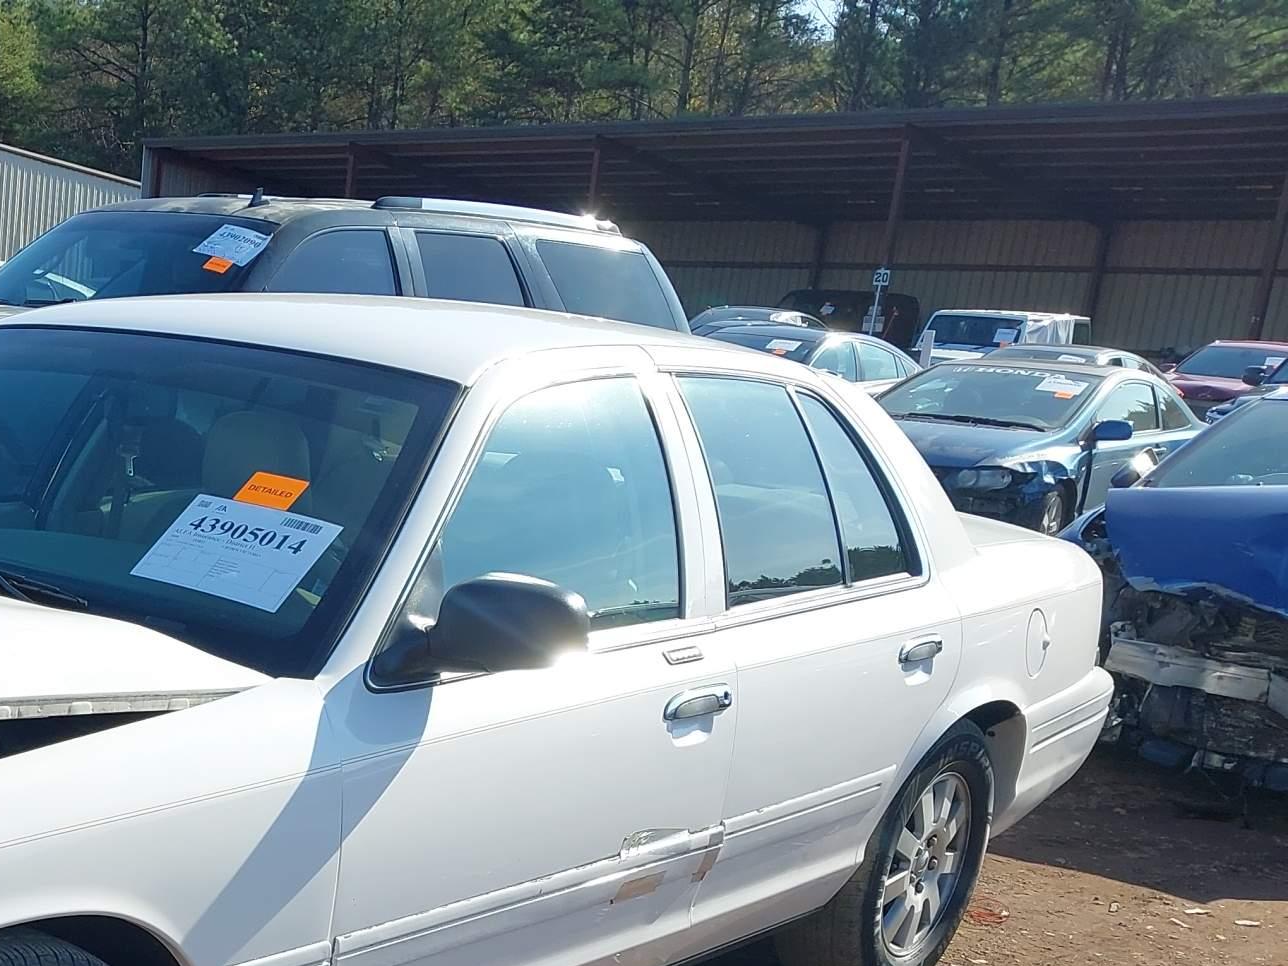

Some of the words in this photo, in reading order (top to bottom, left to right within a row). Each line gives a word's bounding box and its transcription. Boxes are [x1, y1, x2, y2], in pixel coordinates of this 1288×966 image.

[874, 272, 889, 283] 20
[975, 367, 1066, 381] HONDA
[247, 483, 294, 499] DETAILED
[189, 515, 308, 555] 43905014
